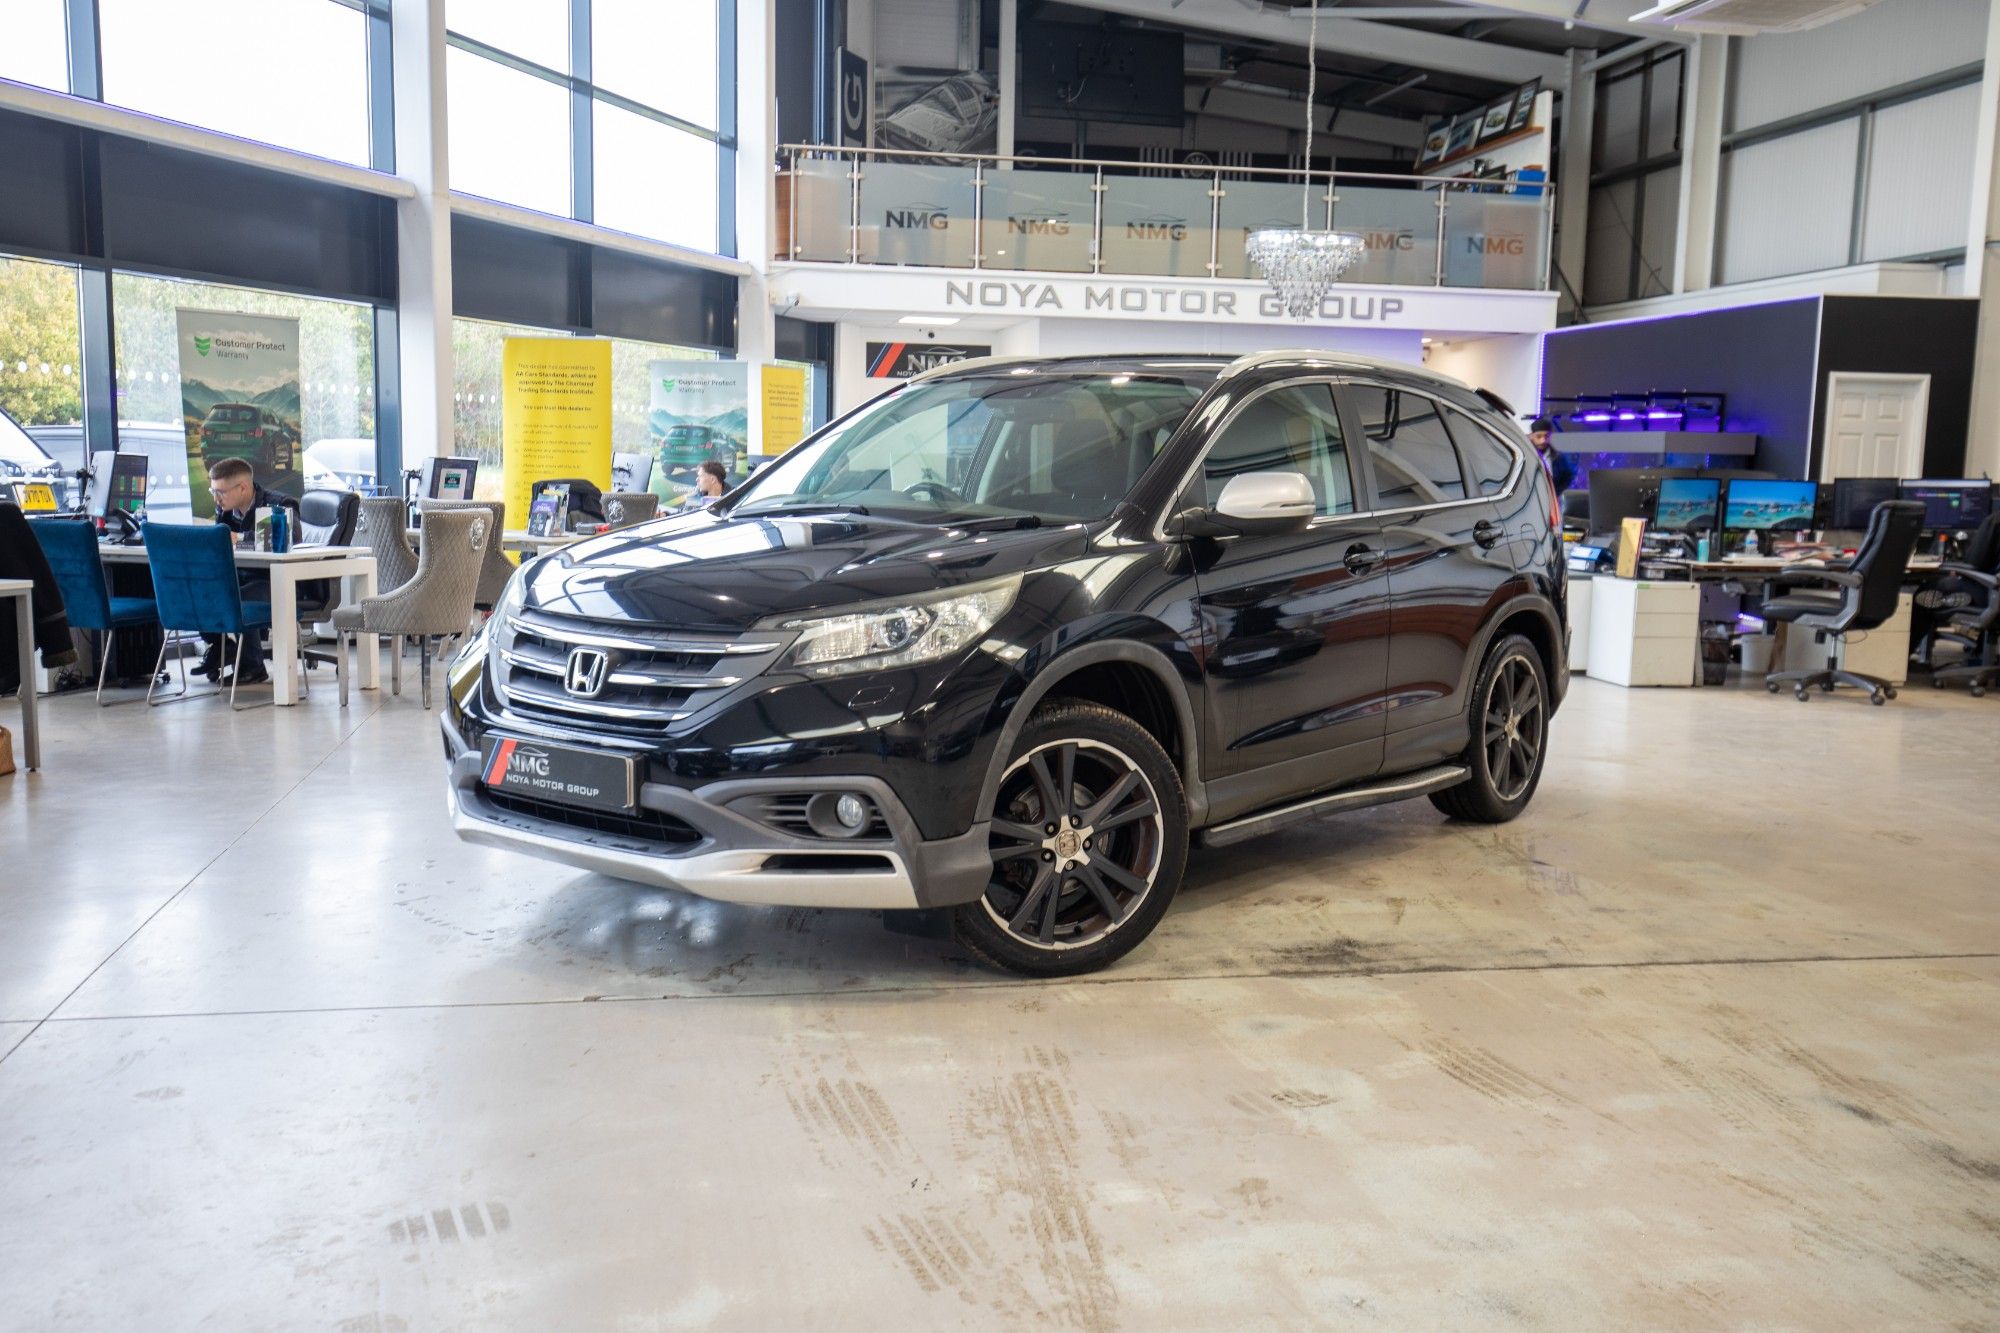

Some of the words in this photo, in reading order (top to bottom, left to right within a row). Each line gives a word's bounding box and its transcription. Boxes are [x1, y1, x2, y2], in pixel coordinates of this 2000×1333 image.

[885, 210, 948, 230] NMG
[1007, 216, 1070, 236] NMG
[1126, 222, 1188, 241] NMG
[1467, 237, 1524, 255] NMG
[946, 280, 1062, 309] NOYA
[1084, 286, 1237, 315] MOTOR
[215, 338, 254, 349] Customer
[256, 341, 286, 352] Protect
[216, 350, 249, 360] Warranty
[907, 354, 967, 372] NM
[506, 752, 550, 776] NMG
[506, 774, 530, 784] NOYA
[532, 778, 564, 791] MOTOR
[567, 784, 600, 797] GROUP
